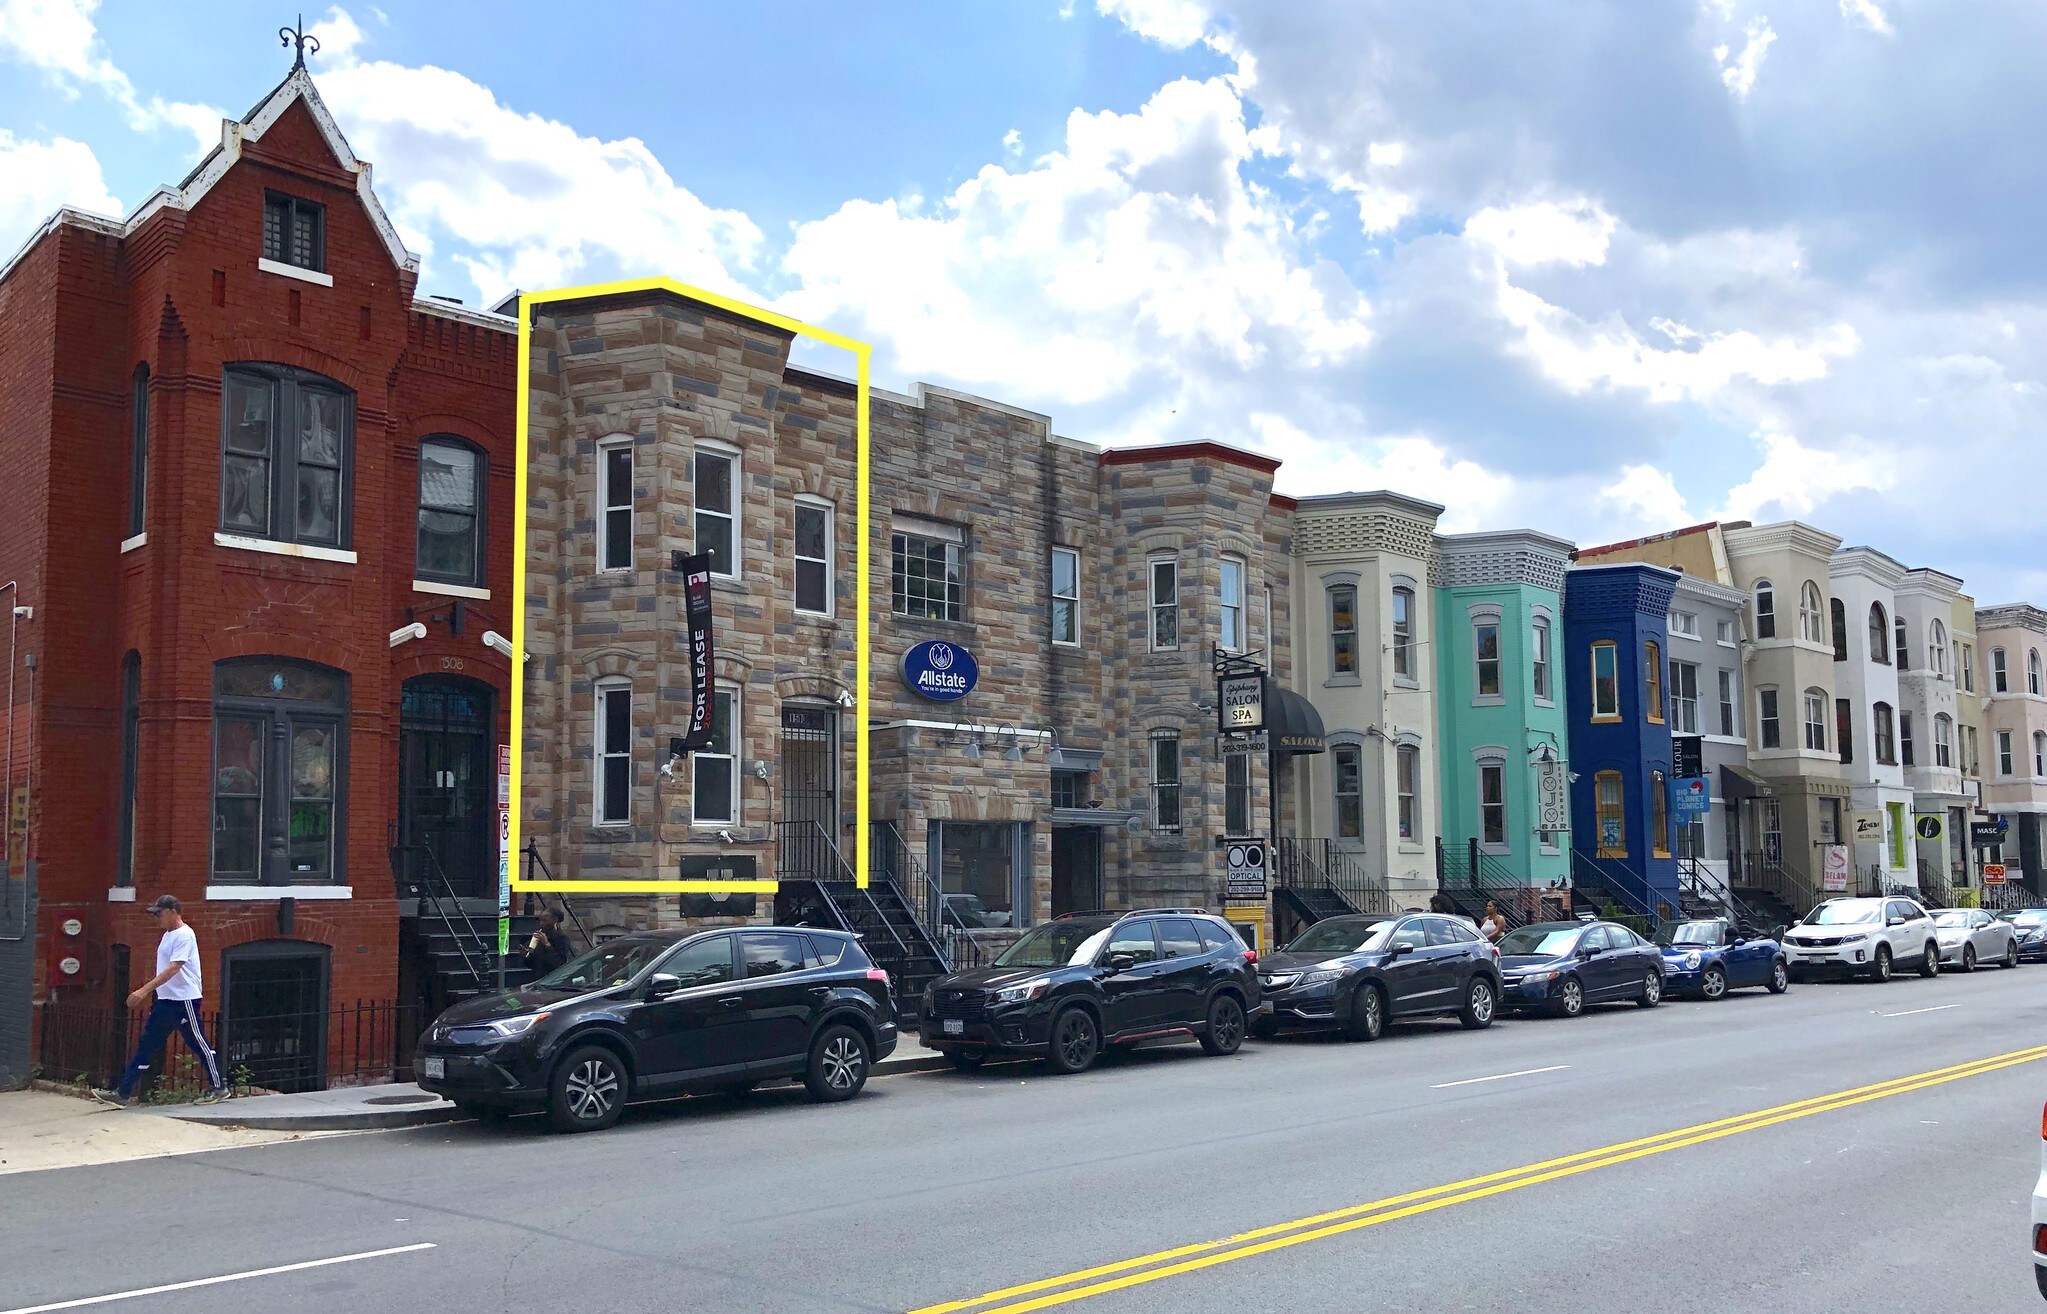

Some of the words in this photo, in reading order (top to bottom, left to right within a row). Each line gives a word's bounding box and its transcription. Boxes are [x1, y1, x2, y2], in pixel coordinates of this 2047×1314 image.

[441, 657, 464, 670] 1508
[695, 629, 706, 689] LEASE
[918, 670, 966, 688] Allstate
[1226, 683, 1258, 695] Epiphany
[1226, 694, 1260, 706] SALON
[693, 693, 705, 732] FOR
[1232, 710, 1252, 720] SPA
[1223, 743, 1265, 753] 202-319-1600
[1676, 795, 1705, 803] PLANET
[1677, 802, 1705, 810] COMICS
